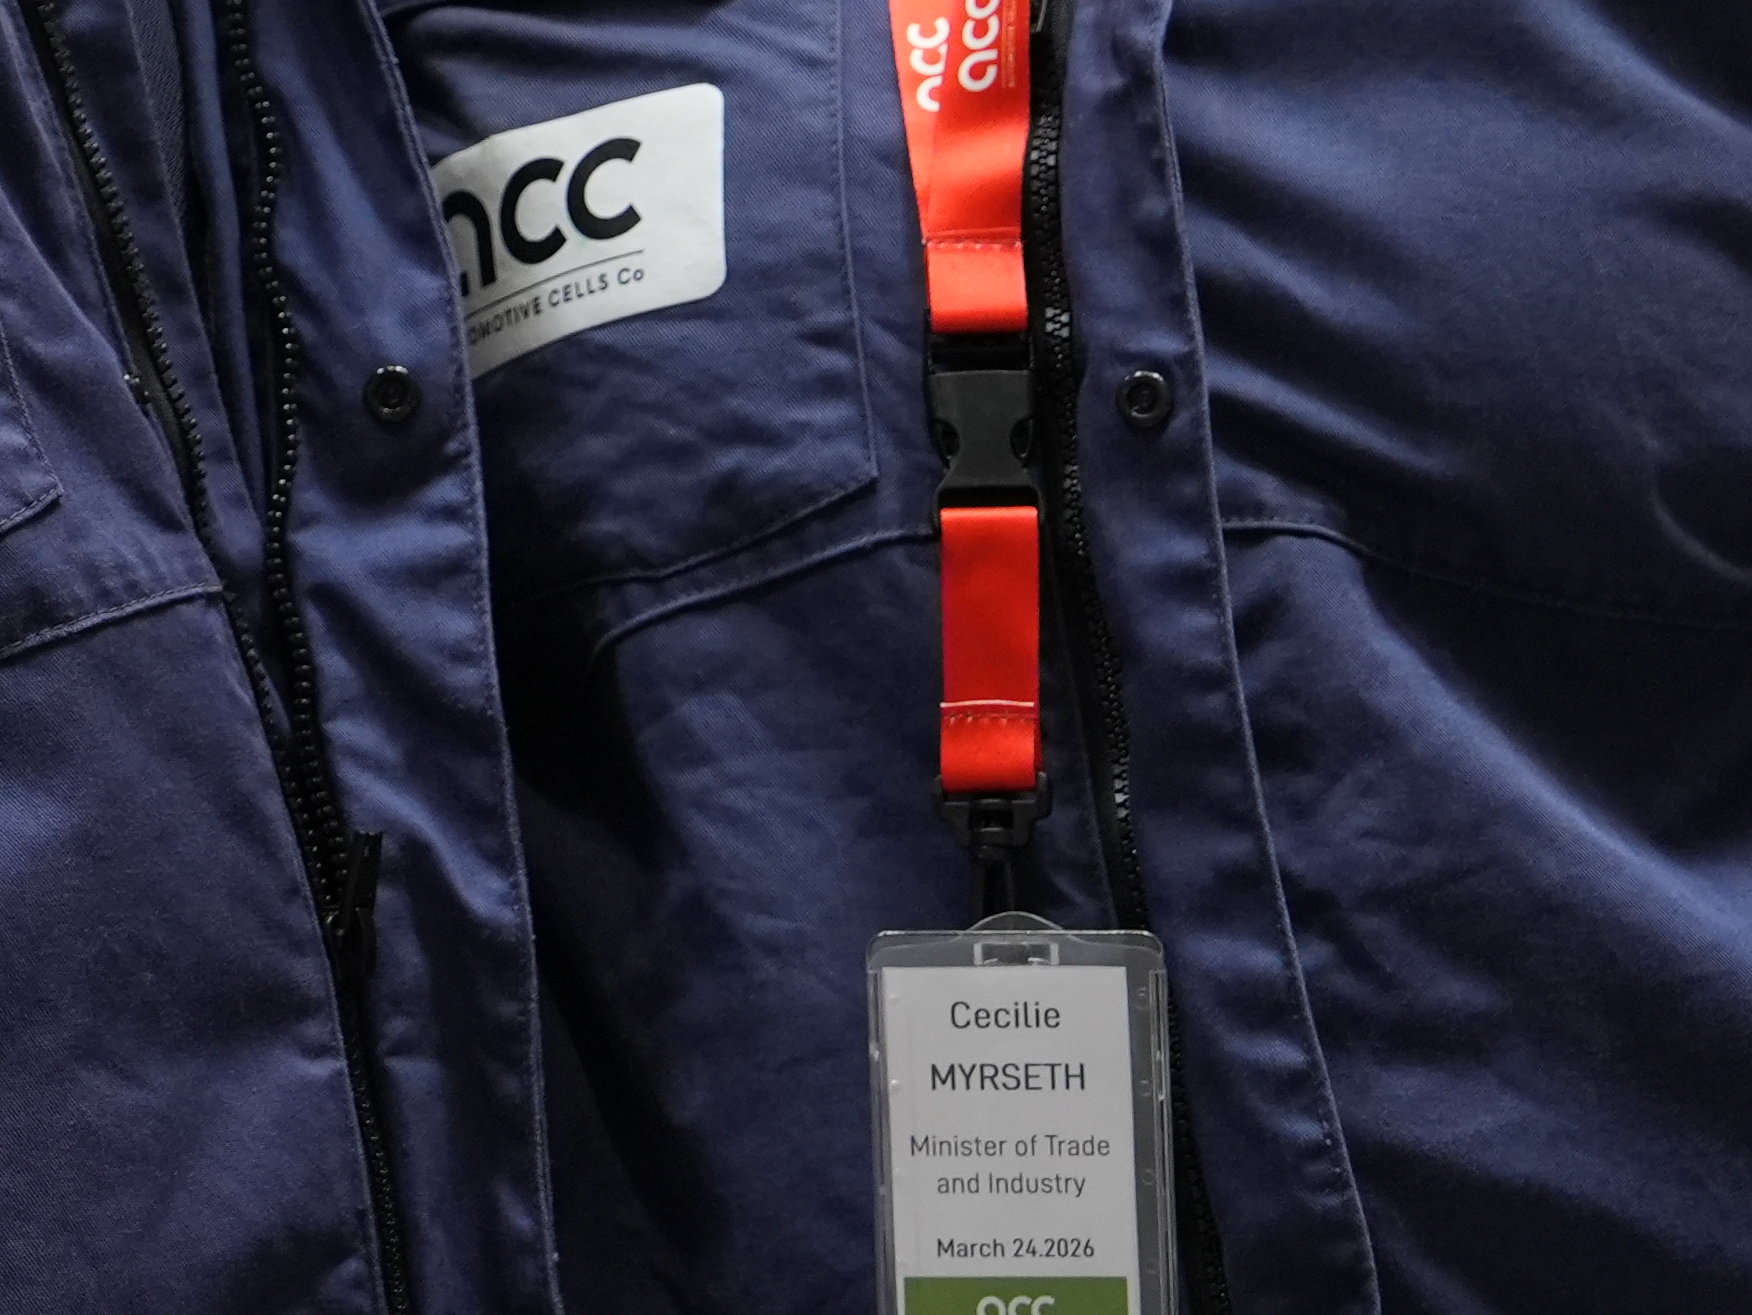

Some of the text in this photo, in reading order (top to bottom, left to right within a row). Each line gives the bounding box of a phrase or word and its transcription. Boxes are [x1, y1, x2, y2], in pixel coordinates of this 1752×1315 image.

[548, 273, 609, 308] CELLS
[617, 267, 645, 285] Co
[949, 1000, 1062, 1030] Cecilie
[929, 1062, 1086, 1091] MYRSETH
[909, 1134, 1111, 1157] Minister of Trade
[936, 1171, 1086, 1198] and Industry
[936, 1237, 1095, 1259] March 24.2026
